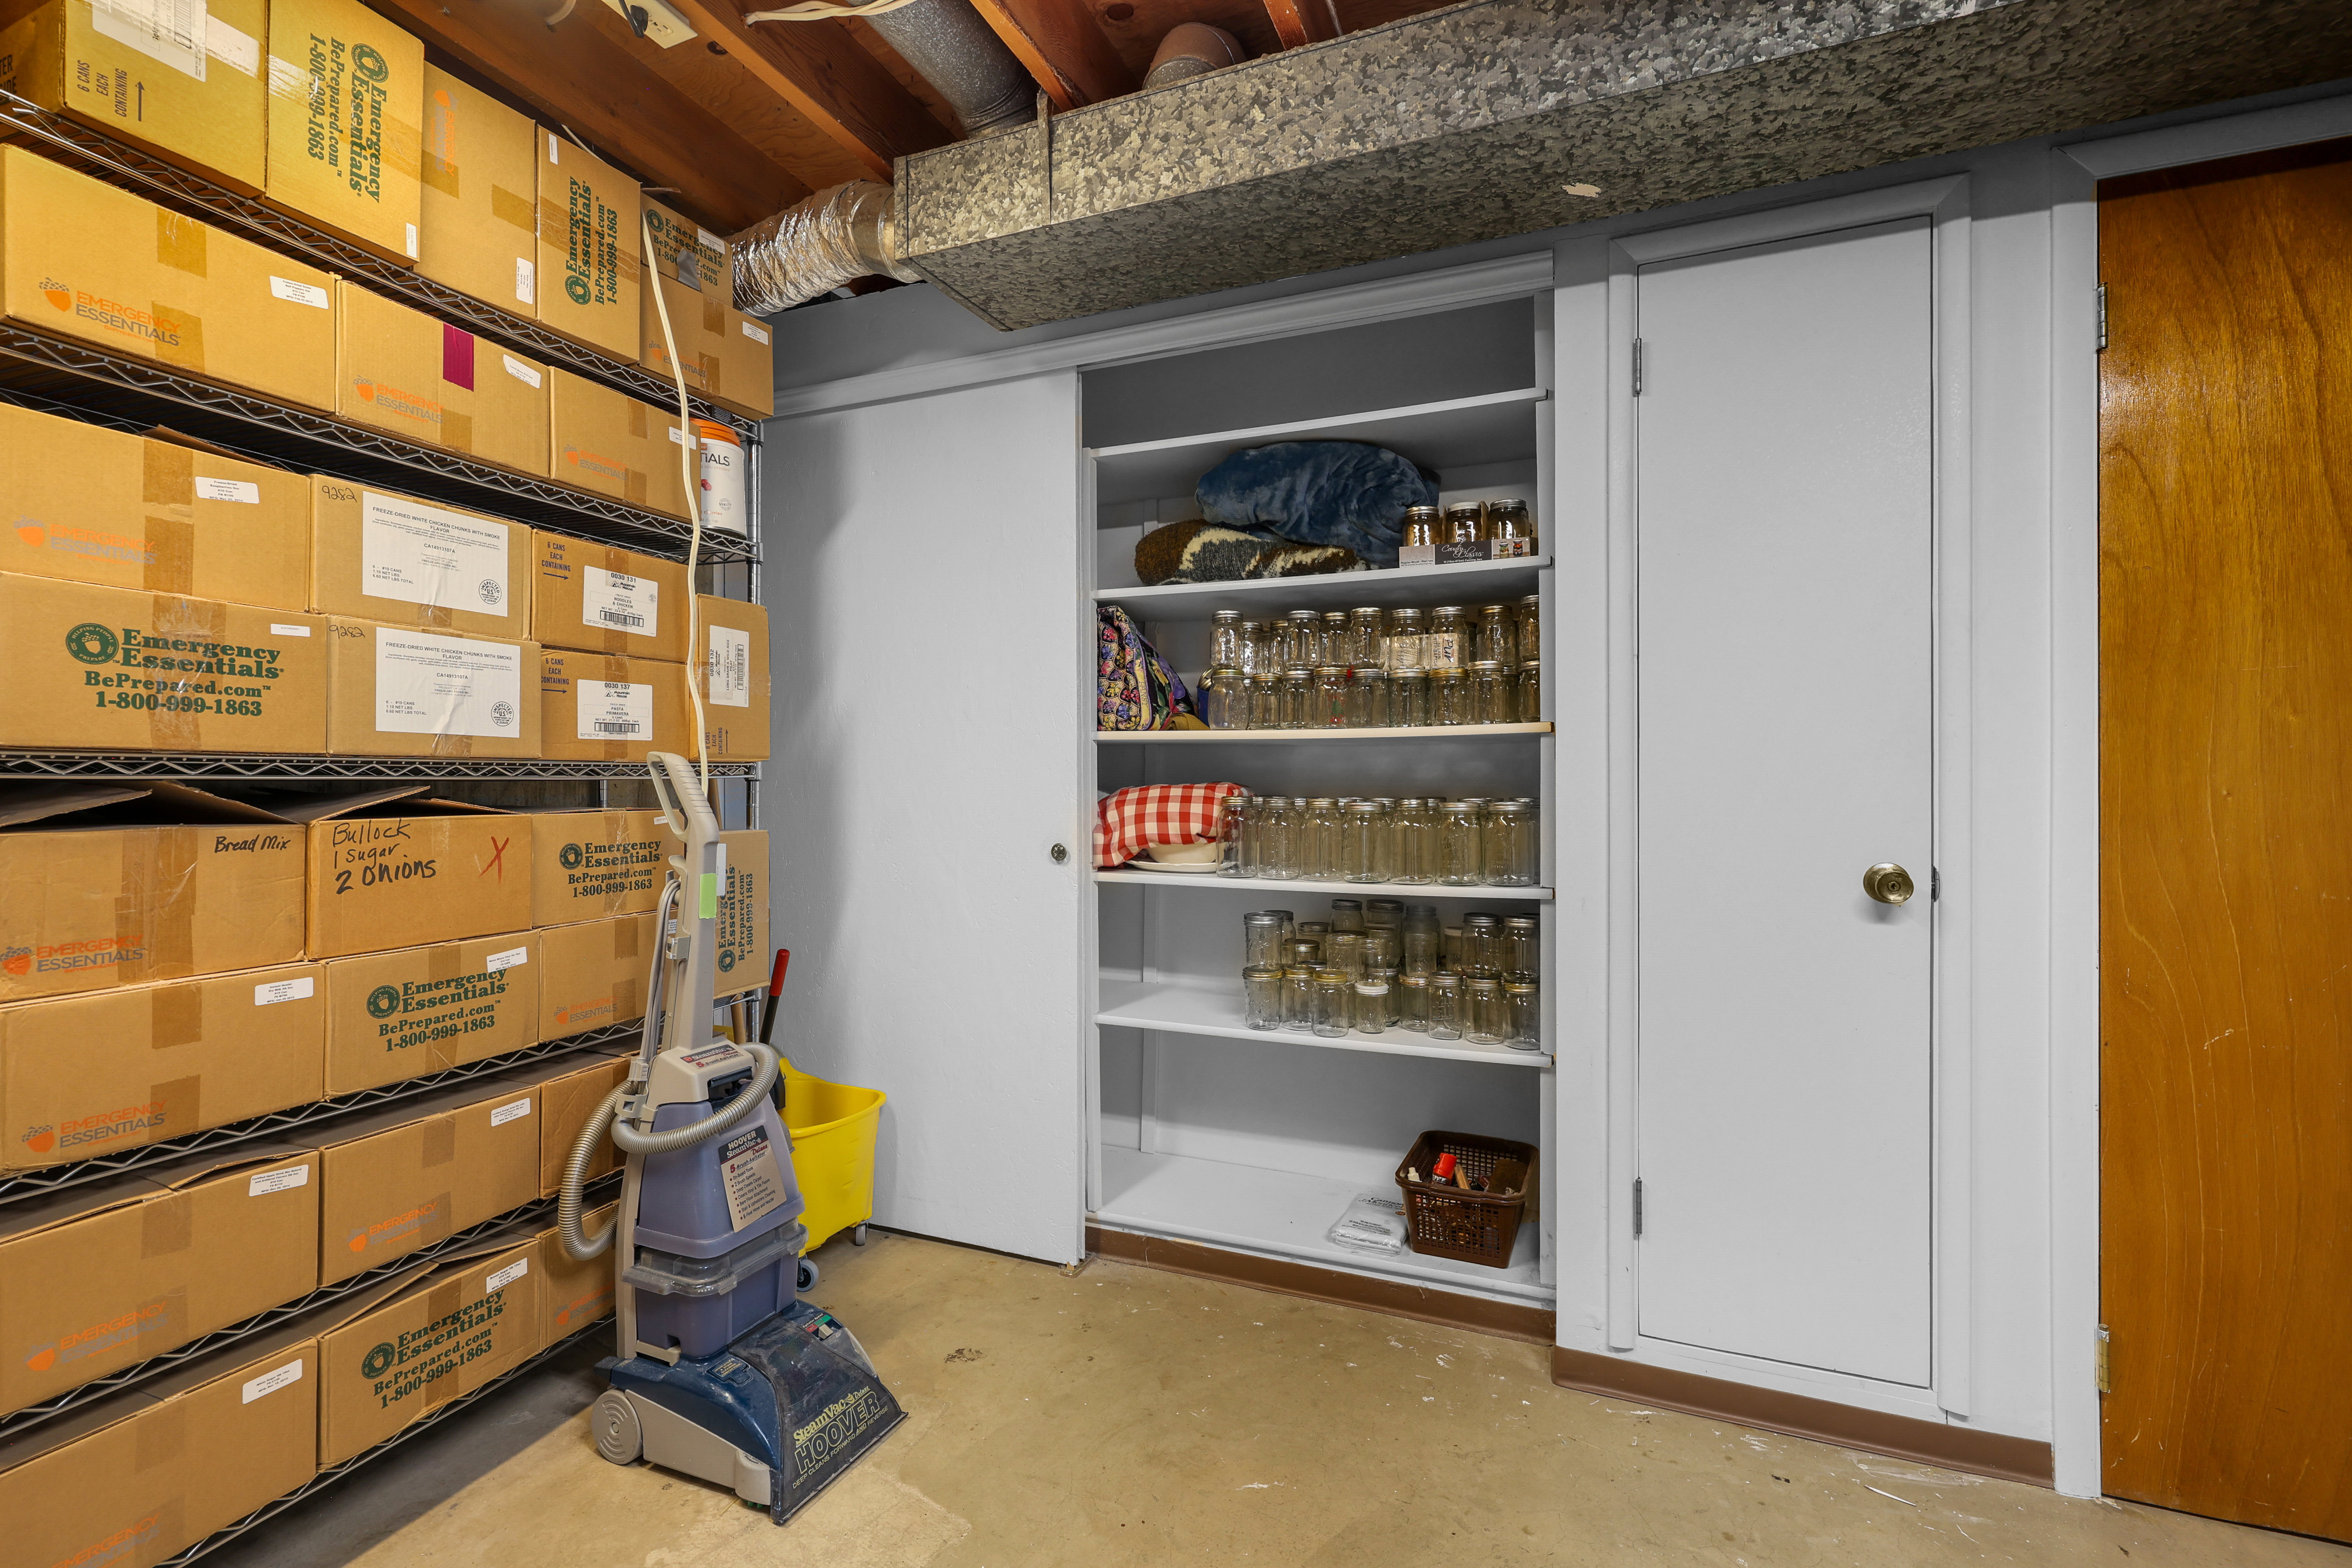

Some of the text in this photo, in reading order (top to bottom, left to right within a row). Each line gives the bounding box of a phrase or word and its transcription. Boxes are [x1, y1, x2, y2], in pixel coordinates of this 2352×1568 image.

[77, 60, 90, 83] CANS
[96, 73, 109, 96] EACH
[115, 69, 127, 117] CONTAINING
[308, 33, 326, 160] 1-800-999-1863
[328, 36, 345, 167] BePrepared.com
[349, 71, 370, 191] Essentials
[364, 83, 387, 203] Emergency
[566, 176, 581, 274] Emergency
[577, 184, 591, 281] Essentials
[595, 204, 606, 305] BePrepared.com
[607, 209, 617, 305] 1-800-999-1863
[666, 228, 723, 268] Essentials
[76, 303, 179, 346] ESSENTIALS
[77, 291, 181, 333] EMERGENCY
[377, 383, 445, 413] EMERGENCY
[377, 395, 443, 423] ESSENTIALS
[580, 458, 627, 480] ESSENTIALS
[322, 485, 357, 503] 9282
[373, 506, 411, 519] FREEZE-DRIED
[429, 520, 450, 528] CHICKEN
[451, 525, 471, 533] CHUNKS
[50, 524, 156, 552] EMERGENCY
[51, 537, 156, 564] ESSENTIALS
[424, 543, 456, 554] CA14913107A
[553, 543, 565, 552] CANS
[1442, 543, 1464, 552] Country
[542, 560, 571, 572] CONTAINING
[550, 552, 563, 561] EACH
[481, 581, 499, 593] INSPECTED
[71, 626, 94, 640] HELPING
[329, 624, 365, 639] 9282
[78, 653, 107, 662] PREPARE
[122, 628, 281, 664] Emergency
[386, 642, 423, 651] FREEZE-DRIED
[120, 647, 279, 679] Essentials
[84, 670, 262, 698] BePrepared.com
[541, 676, 569, 685] CONTAINING
[96, 691, 262, 717] 1-800-999-1863
[494, 704, 512, 714] INSPECTED
[214, 835, 292, 854] Bread Mix
[332, 818, 411, 847] Bullock
[585, 841, 661, 854] Emergency
[585, 851, 660, 868] Essentials
[336, 869, 354, 895] 2
[568, 869, 652, 884] BePrepared.com
[573, 879, 652, 898] 1-800-999-1863
[727, 866, 735, 948] Essentials
[37, 934, 143, 959] EMERGENCY
[37, 949, 144, 972] ESSENTIALS
[402, 969, 506, 996] Emergency
[402, 981, 506, 1013] Essentials
[379, 1004, 494, 1036] BePrepared.com
[570, 1004, 617, 1023] ESSENTIALS
[387, 1015, 495, 1052] 1-800-999-1863
[692, 1048, 726, 1060] SteamVac
[60, 1100, 167, 1134] EMERGENCY
[60, 1113, 166, 1148] ESSENTIALS
[727, 1140, 756, 1158] SteamVac
[728, 1131, 756, 1150] HOOVER
[749, 1151, 766, 1163] Agitator
[746, 1172, 756, 1182] Speeds
[753, 1187, 768, 1200] Attachment
[370, 1202, 437, 1235] EMERGENCY
[61, 1300, 168, 1350] EMERGENCY
[397, 1289, 505, 1349] Emergency
[397, 1304, 503, 1367] Essentials
[374, 1328, 492, 1396] BePrepared.com
[381, 1339, 492, 1409] 1-800-999-1863
[853, 1386, 870, 1399] Deluxe
[793, 1399, 846, 1445] SteamVac
[794, 1391, 880, 1475] HOOVER
[793, 1406, 888, 1489] DEEP CLEANS FORWARD AND REVERSE
